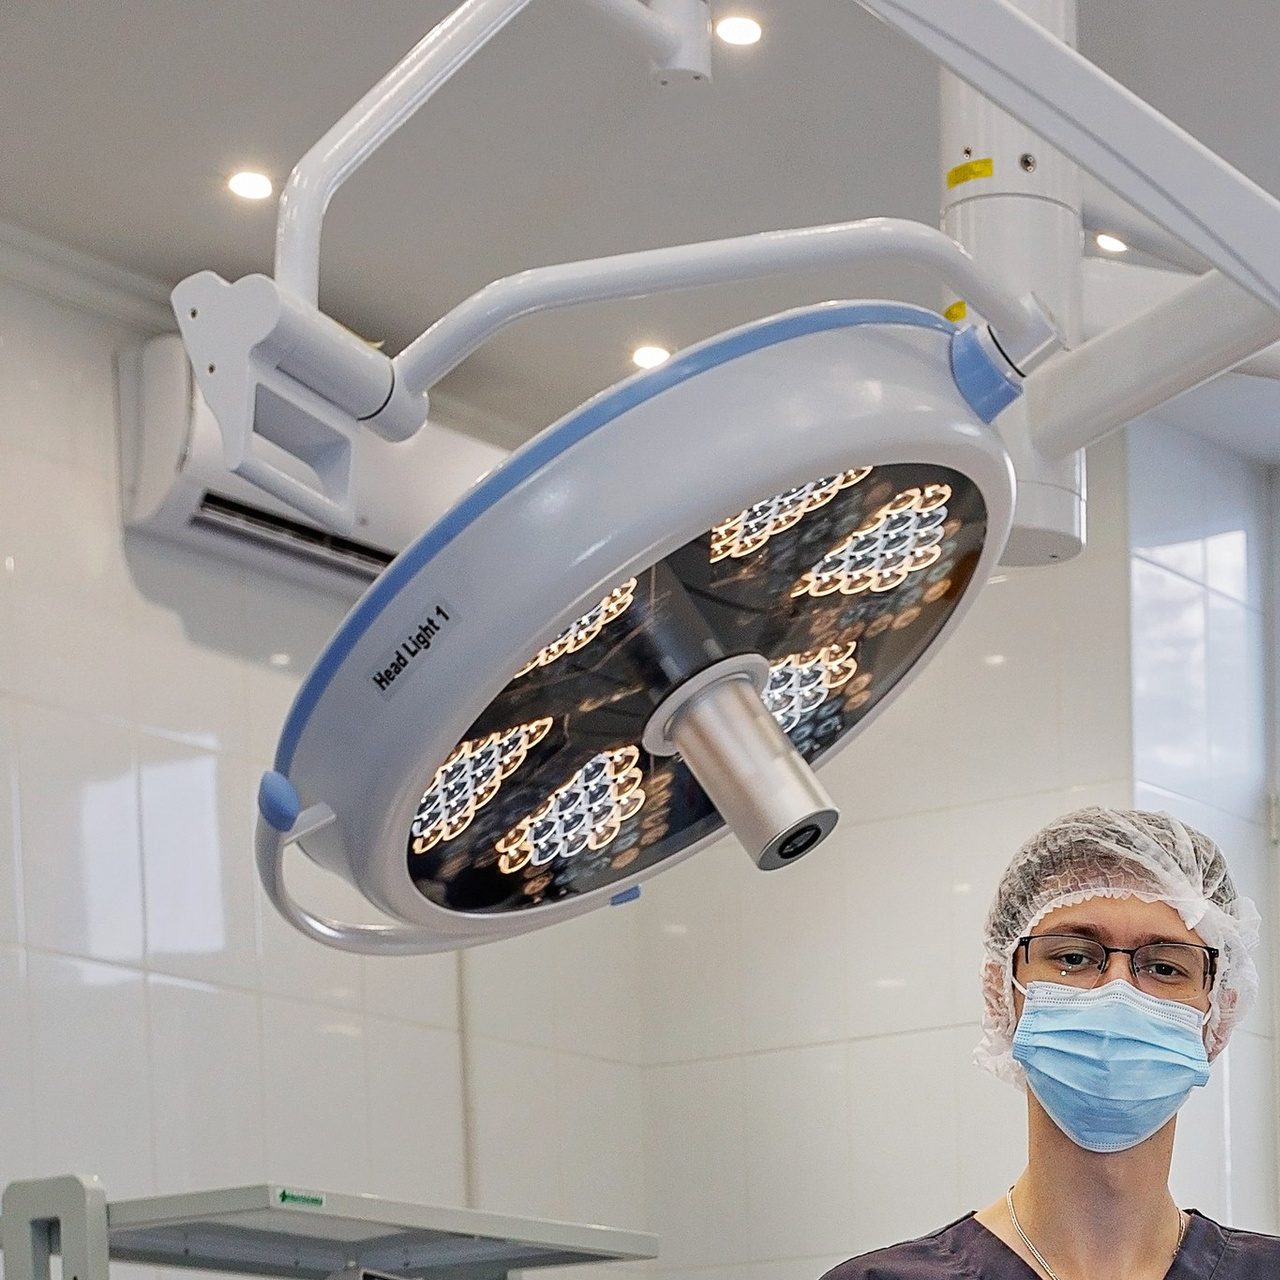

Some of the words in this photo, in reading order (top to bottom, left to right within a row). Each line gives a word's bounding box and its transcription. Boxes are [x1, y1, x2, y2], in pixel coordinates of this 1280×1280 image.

[373, 649, 409, 691] Head
[401, 617, 441, 658] Light
[435, 605, 450, 621] 1
